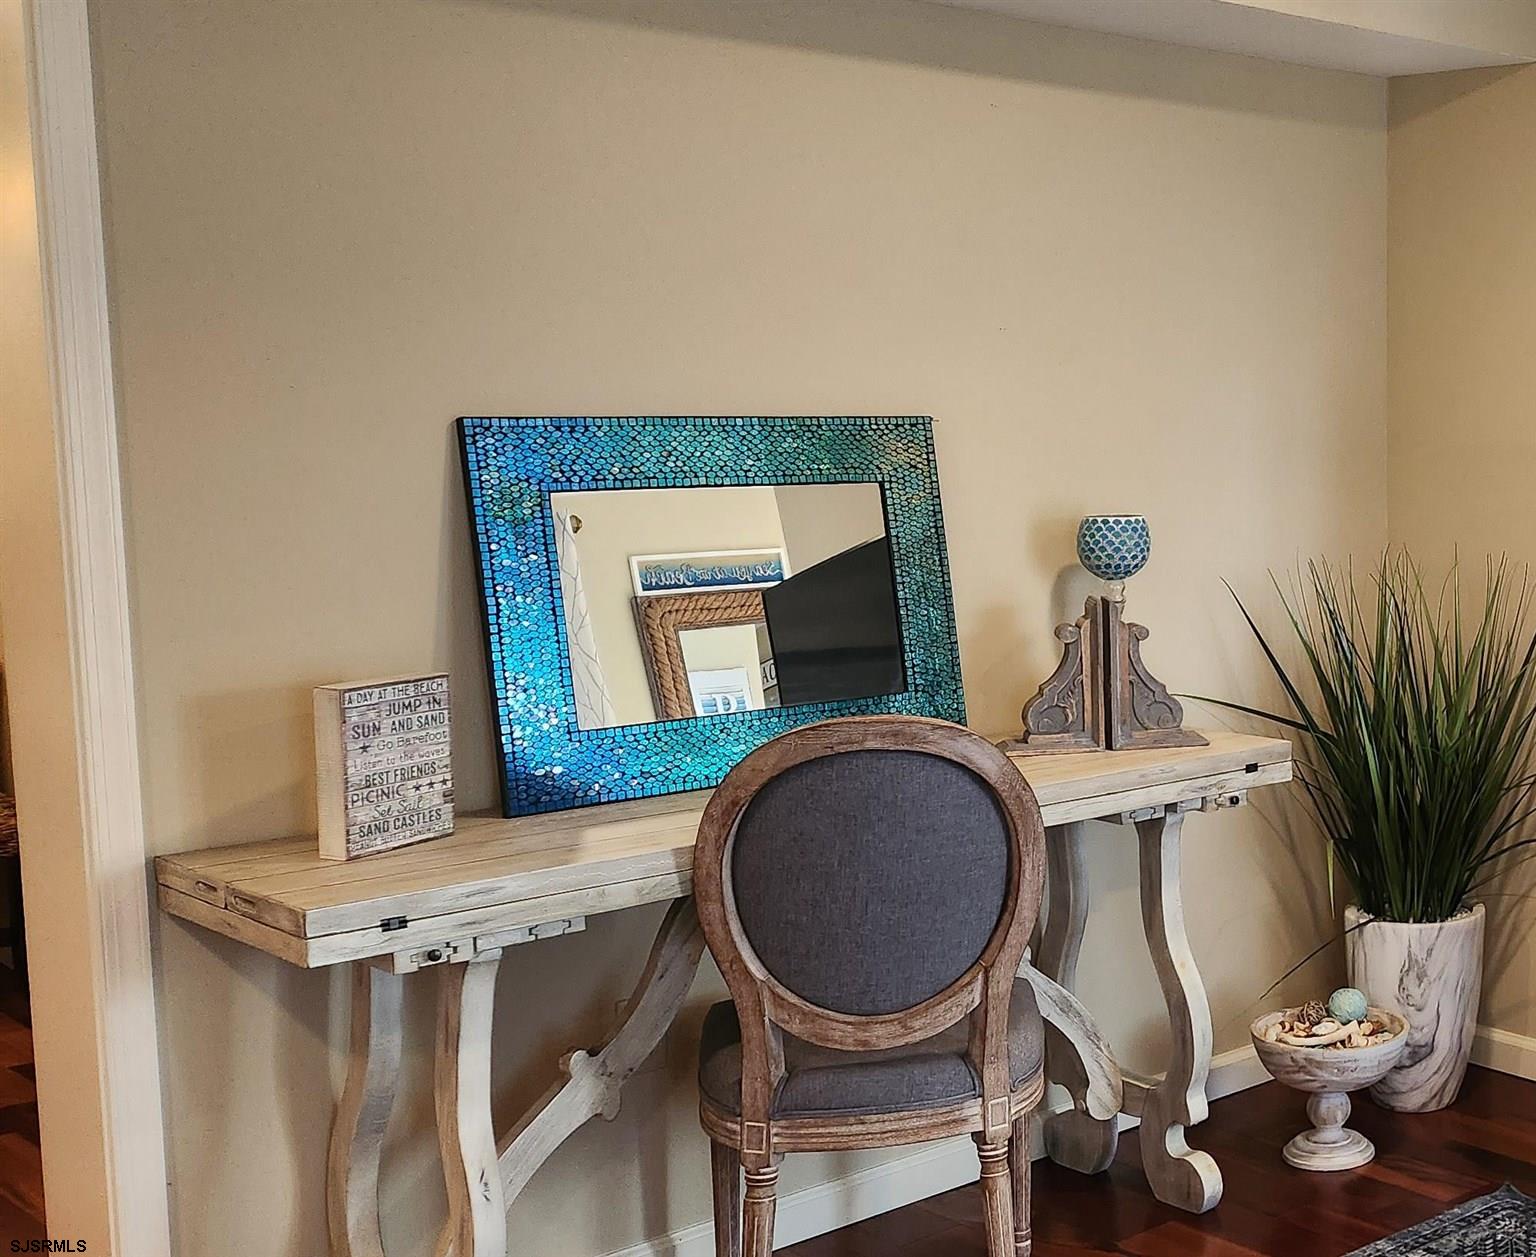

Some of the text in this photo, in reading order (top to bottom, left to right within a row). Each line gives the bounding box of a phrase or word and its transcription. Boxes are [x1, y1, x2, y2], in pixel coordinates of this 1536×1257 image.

[347, 681, 443, 705] A DAY AT THE BEACH
[385, 695, 441, 716] JUMP IN
[352, 711, 445, 740] SUN AND SAND
[376, 731, 448, 751] Go Barefoot
[364, 761, 437, 788] BEST FRIENDS
[358, 820, 390, 838] SAND
[393, 808, 442, 830] CASTLES
